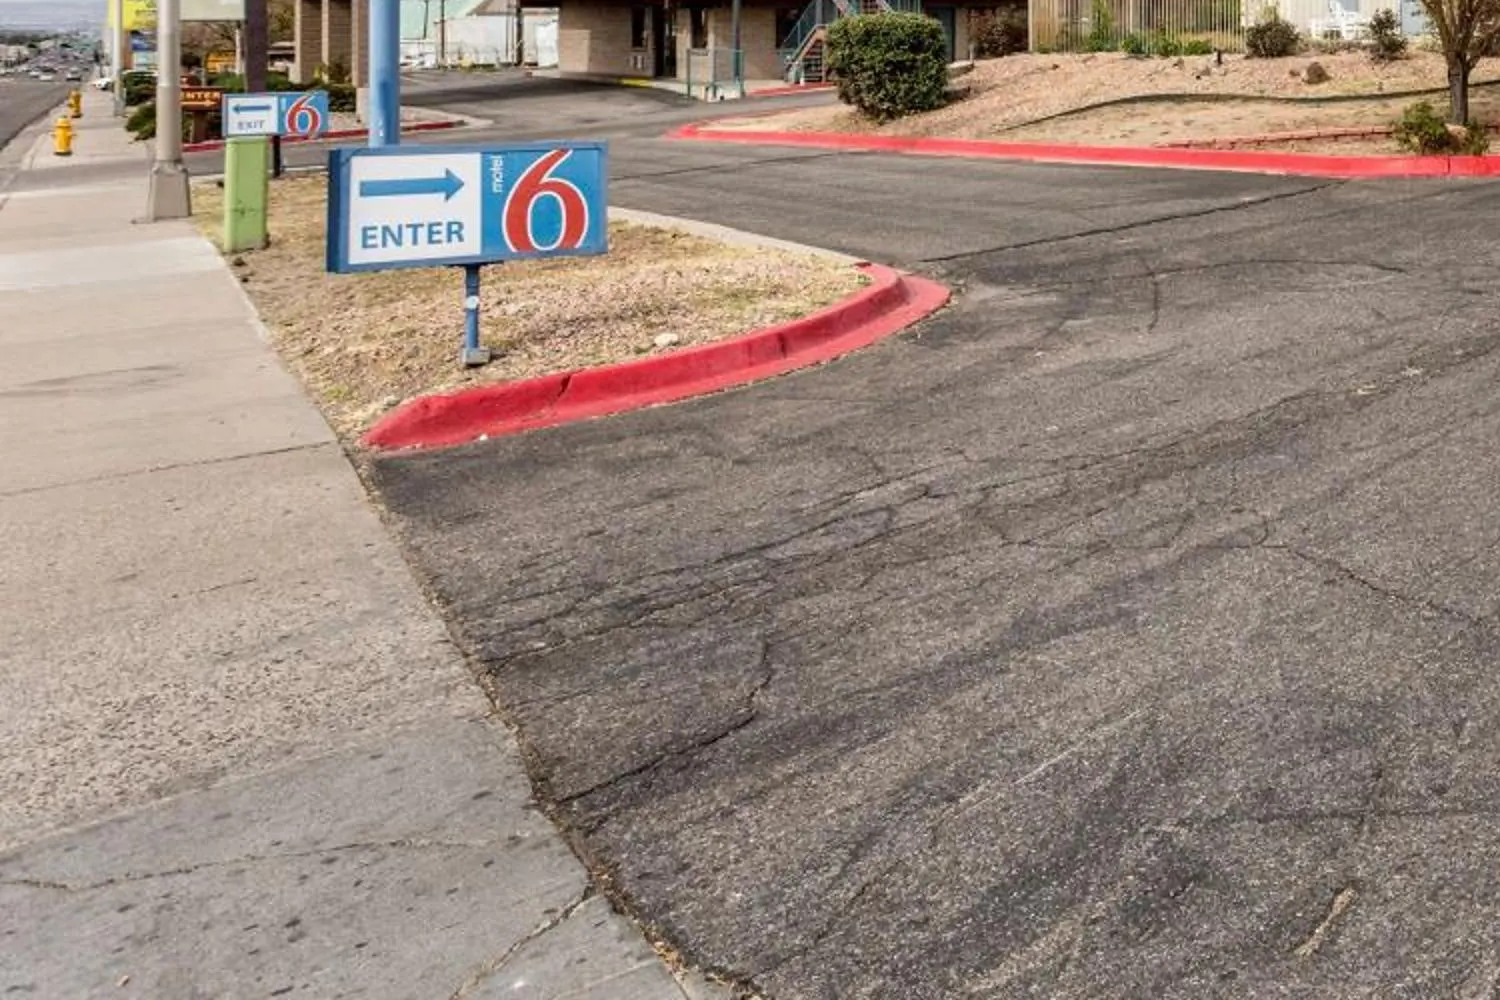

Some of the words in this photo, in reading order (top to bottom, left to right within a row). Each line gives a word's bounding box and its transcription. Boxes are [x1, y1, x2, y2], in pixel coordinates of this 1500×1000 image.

[237, 119, 265, 130] EXIT
[286, 94, 320, 137] 6
[490, 154, 503, 193] motel
[502, 148, 588, 253] 6
[361, 220, 465, 249] ENTER
